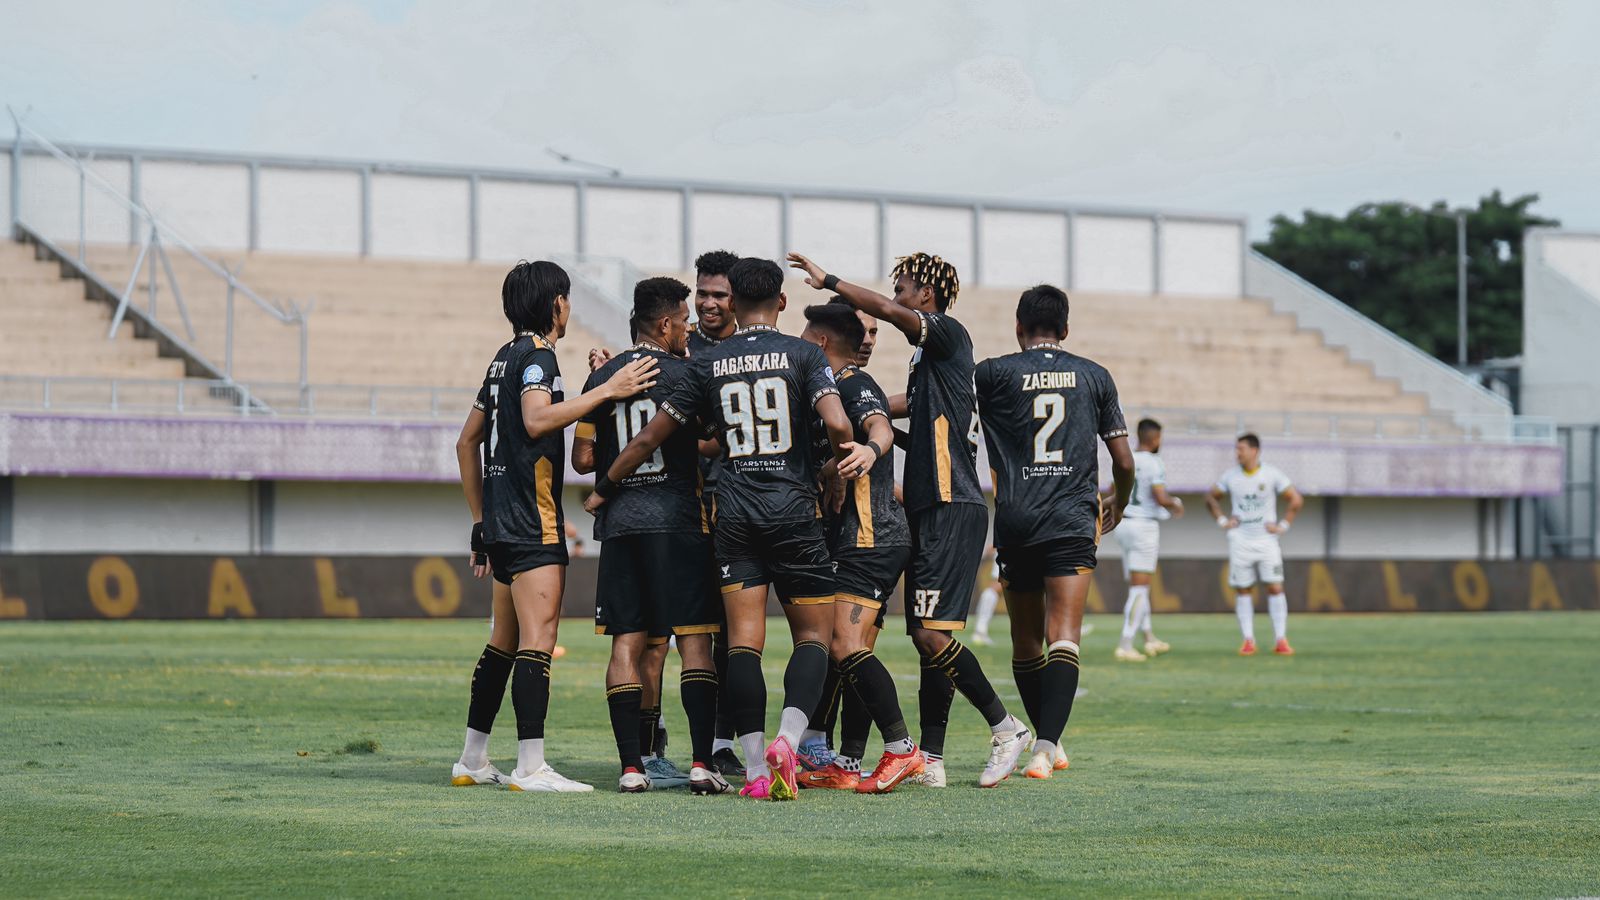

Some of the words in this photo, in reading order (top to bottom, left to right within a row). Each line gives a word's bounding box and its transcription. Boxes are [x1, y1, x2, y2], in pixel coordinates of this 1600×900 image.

[713, 352, 789, 378] BAGASKARA
[1022, 371, 1077, 391] ZAENURI
[610, 398, 665, 475] 10
[720, 376, 793, 458] 99
[1033, 392, 1066, 463] 2
[914, 589, 941, 618] 37
